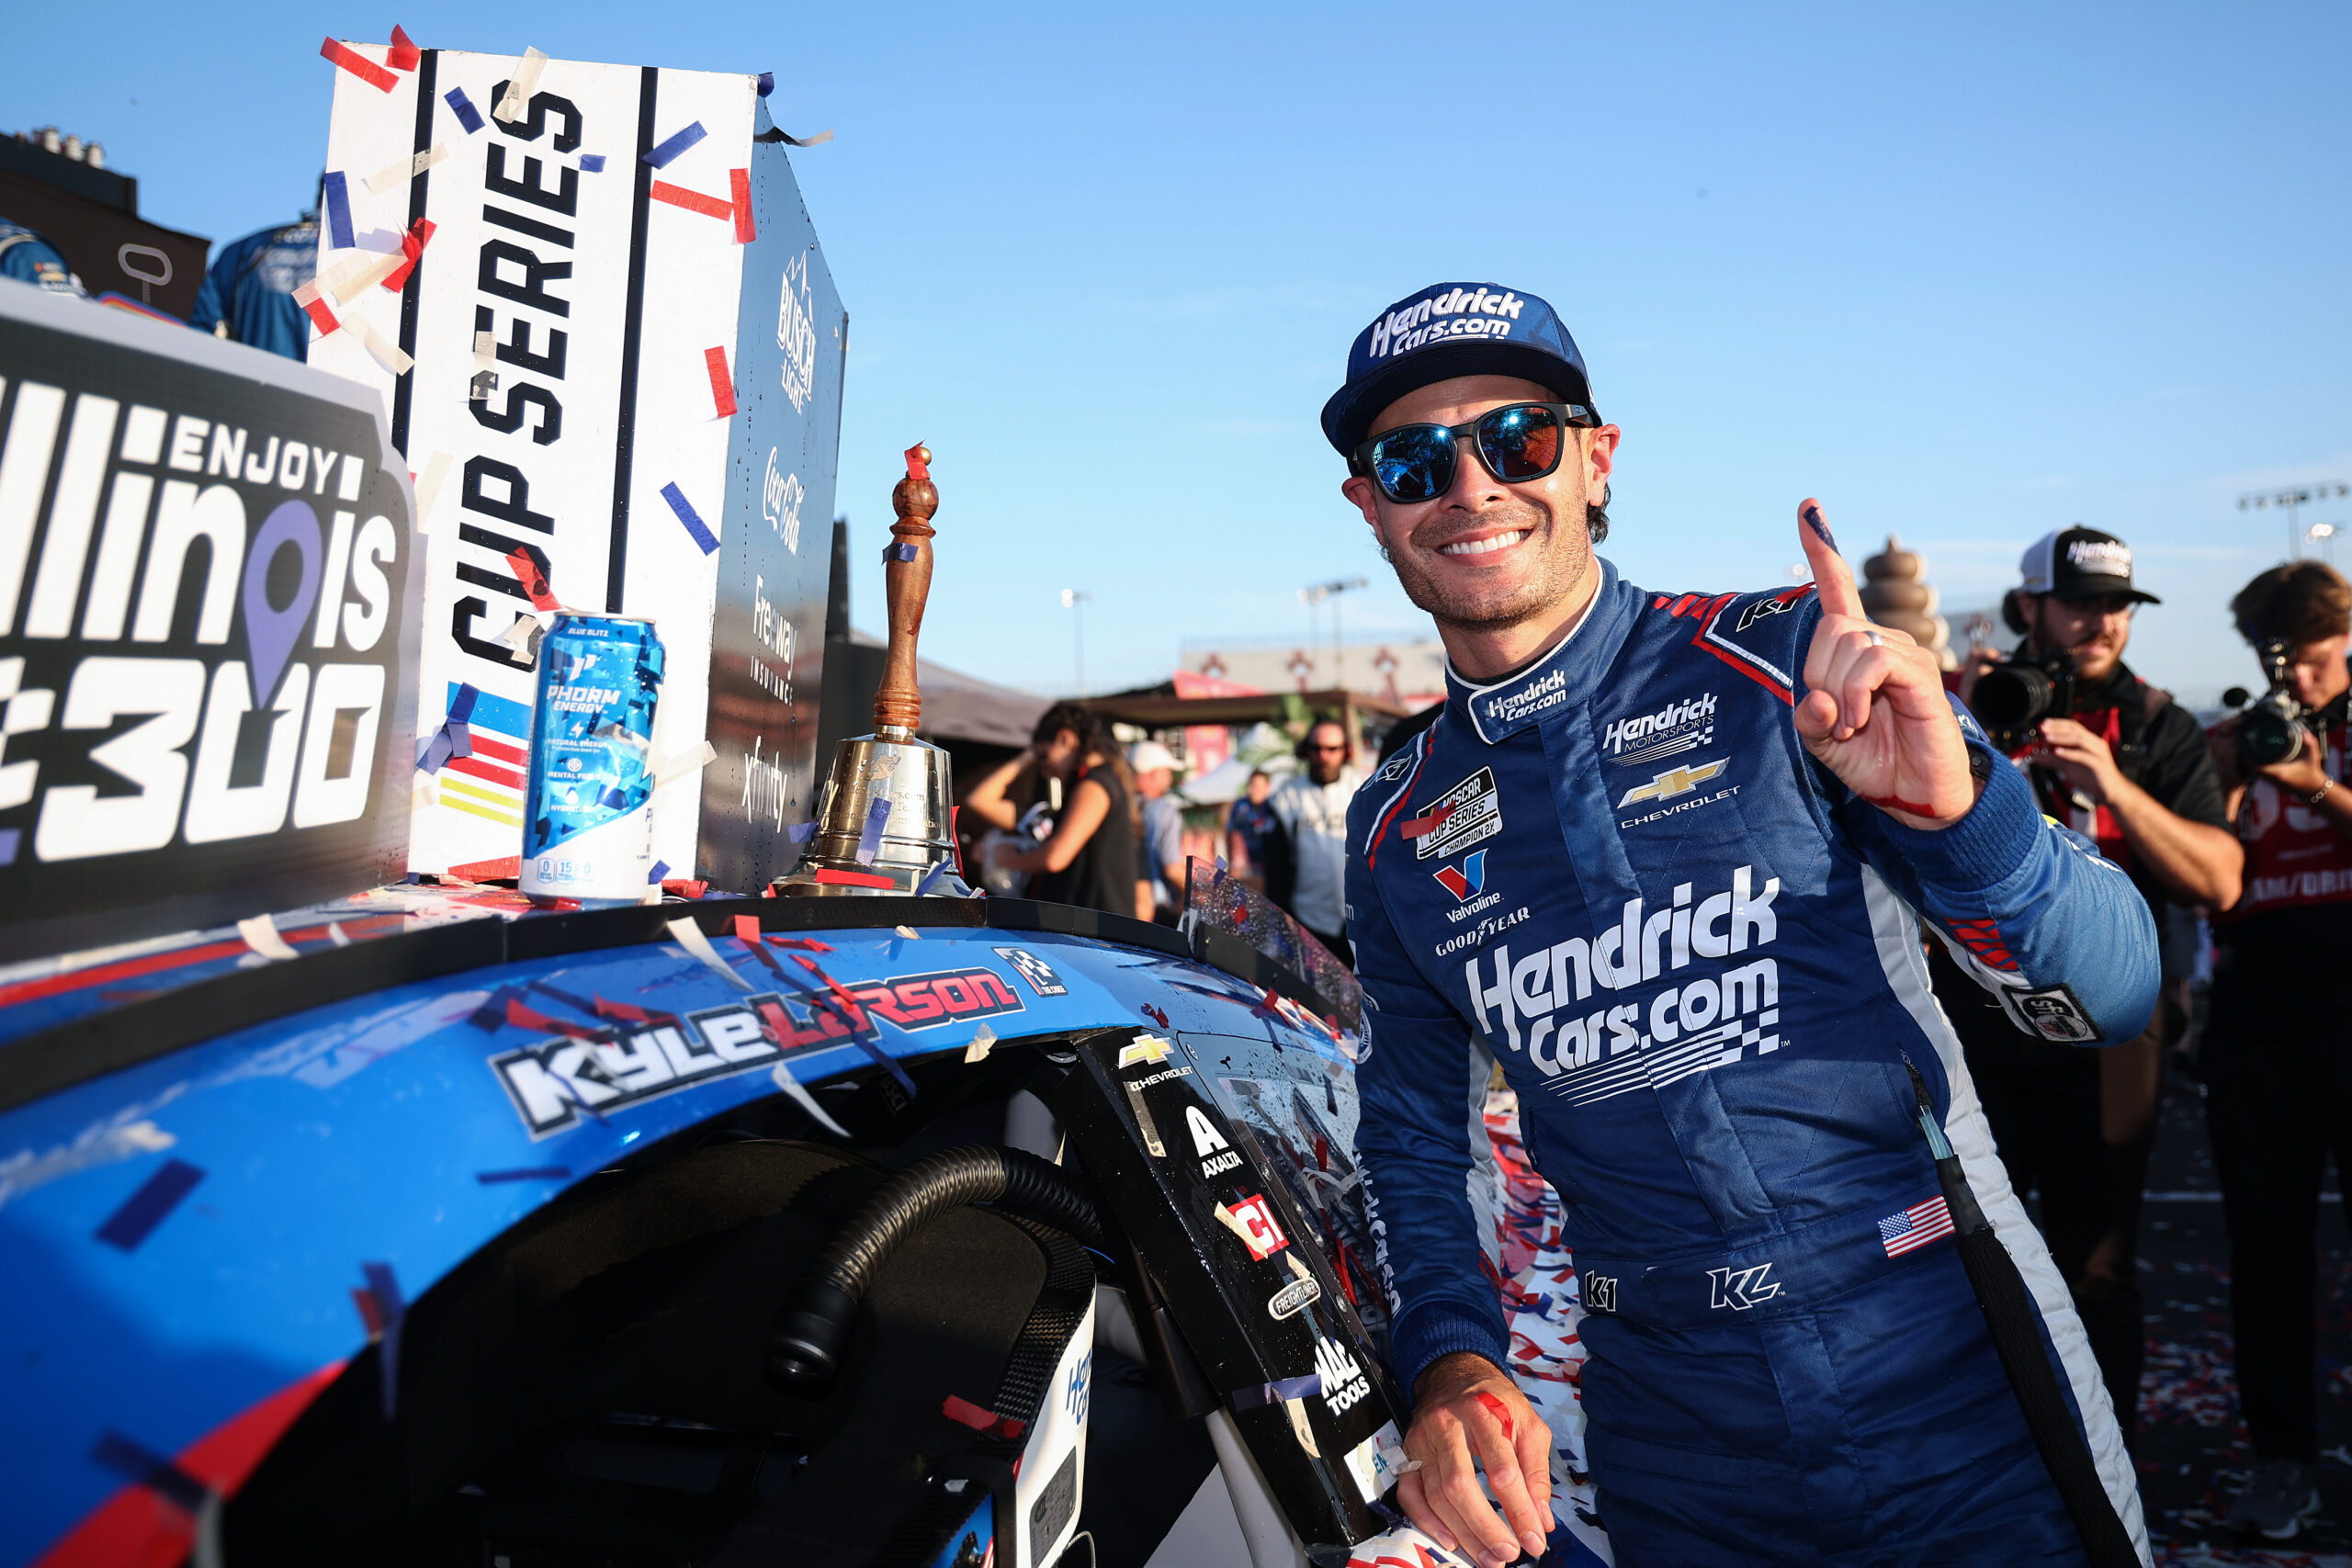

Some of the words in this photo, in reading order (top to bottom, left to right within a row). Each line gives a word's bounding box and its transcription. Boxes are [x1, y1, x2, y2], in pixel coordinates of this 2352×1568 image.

[468, 79, 583, 447] SERIES
[777, 272, 816, 402] BUSCH
[1369, 288, 1524, 358] Hendrick
[1392, 318, 1511, 356] Cars.com
[781, 358, 804, 416] LIGHT
[168, 415, 338, 495] ENJOY
[0, 375, 397, 655] llinois
[451, 456, 555, 673] CUP
[568, 627, 586, 637] BLUE
[587, 628, 609, 637] BLITZ
[752, 574, 797, 681] Freeway
[546, 685, 622, 705] PHORM
[750, 655, 794, 707] INSURANCE
[1488, 670, 1566, 718] Hendrick
[553, 701, 605, 714] ENERGY
[1507, 689, 1566, 722] Cars.com
[1602, 692, 1718, 755] Hendrick
[1624, 715, 1715, 753] MOTORSPORTS
[547, 771, 576, 779] MENTAL
[741, 735, 787, 834] xfinity
[1442, 777, 1482, 807] NASCAR
[1428, 816, 1448, 843] CUP
[1448, 799, 1486, 831] SERIES
[1621, 785, 1741, 829] CHEVROLET
[1443, 828, 1484, 855] CHAMPION
[1485, 820, 1496, 836] 2X
[543, 860, 549, 873] 0
[560, 861, 572, 874] 15
[1445, 892, 1501, 923] Valvoline
[1465, 865, 1780, 1052] Hendrick
[1529, 957, 1779, 1077] Cars.com
[1130, 1066, 1193, 1092] CHEVROLET
[1201, 1150, 1243, 1179] AXALTA
[1275, 1282, 1318, 1315] FREIGHTLINER
[1586, 1269, 1618, 1312] K1
[1326, 1375, 1371, 1416] TOOLS
